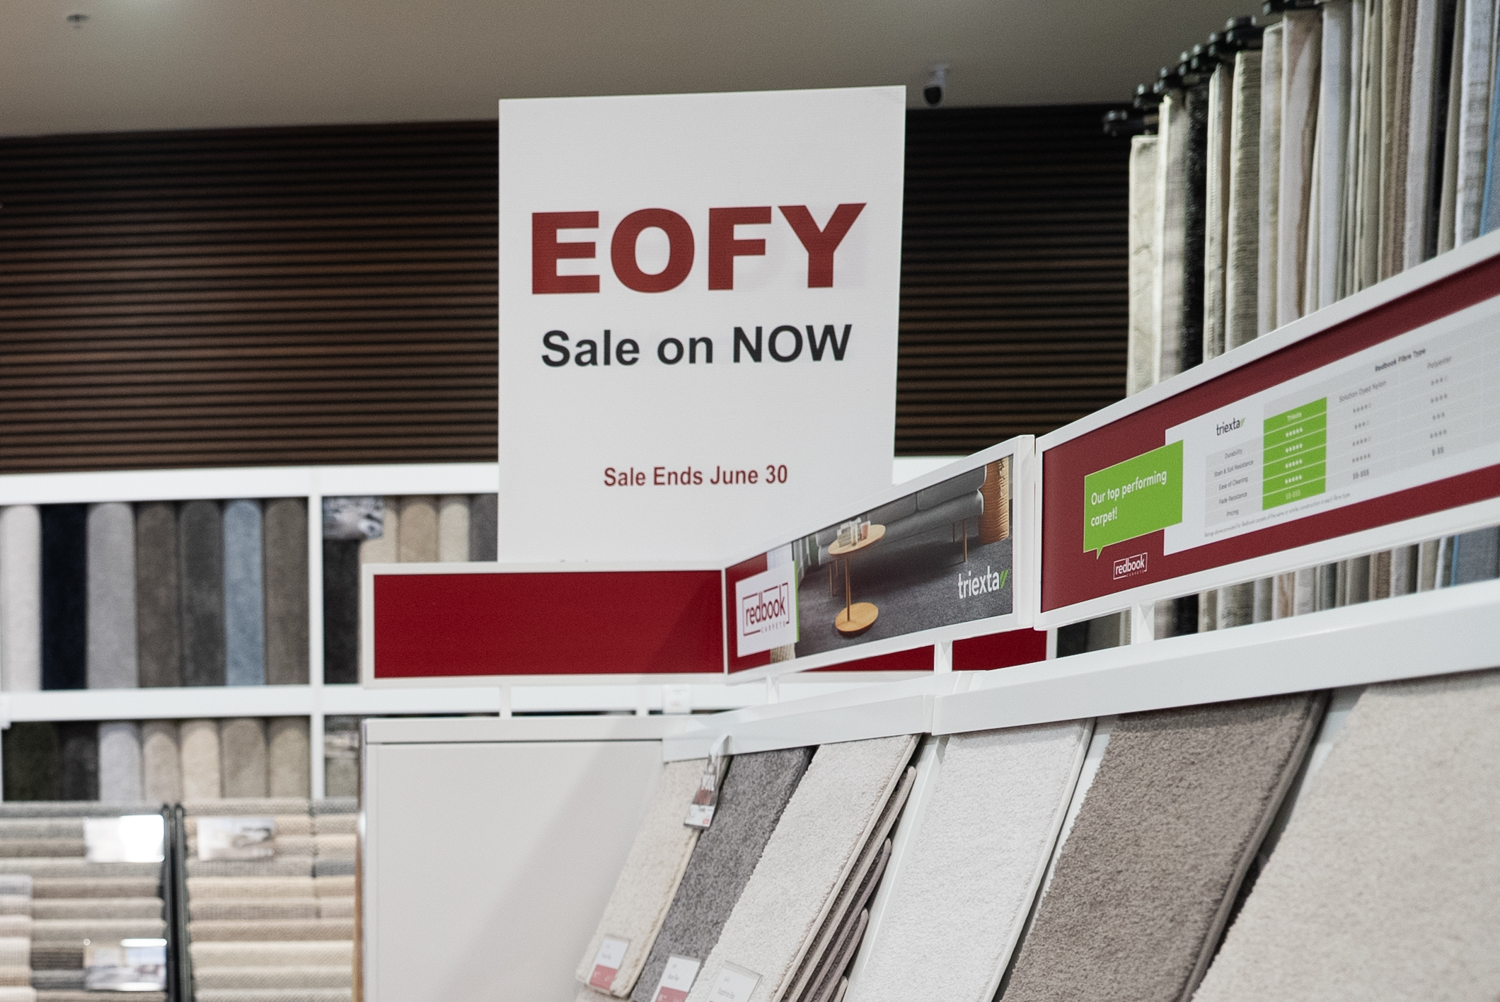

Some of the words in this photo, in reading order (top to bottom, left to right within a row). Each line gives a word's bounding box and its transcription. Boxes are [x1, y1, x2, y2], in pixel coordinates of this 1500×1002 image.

[531, 203, 867, 295] EOFY
[542, 330, 640, 367] Sale
[656, 335, 713, 365] on
[733, 324, 852, 363] NOW
[1216, 418, 1241, 436] triexta
[1224, 449, 1243, 460] Durability
[603, 467, 646, 486] Sale
[653, 467, 703, 486] Ends
[710, 466, 758, 485] June
[765, 465, 788, 484] 30
[1233, 477, 1248, 487] Cleaning
[1091, 491, 1104, 506] Our
[1107, 486, 1120, 504] top
[1121, 470, 1167, 499] performing
[1219, 497, 1227, 505] Fade
[1091, 507, 1118, 528] carpet!
[1226, 509, 1239, 517] Pricing
[1115, 554, 1145, 577] redbook
[958, 566, 1000, 599] triexta
[745, 584, 786, 626] redbook
